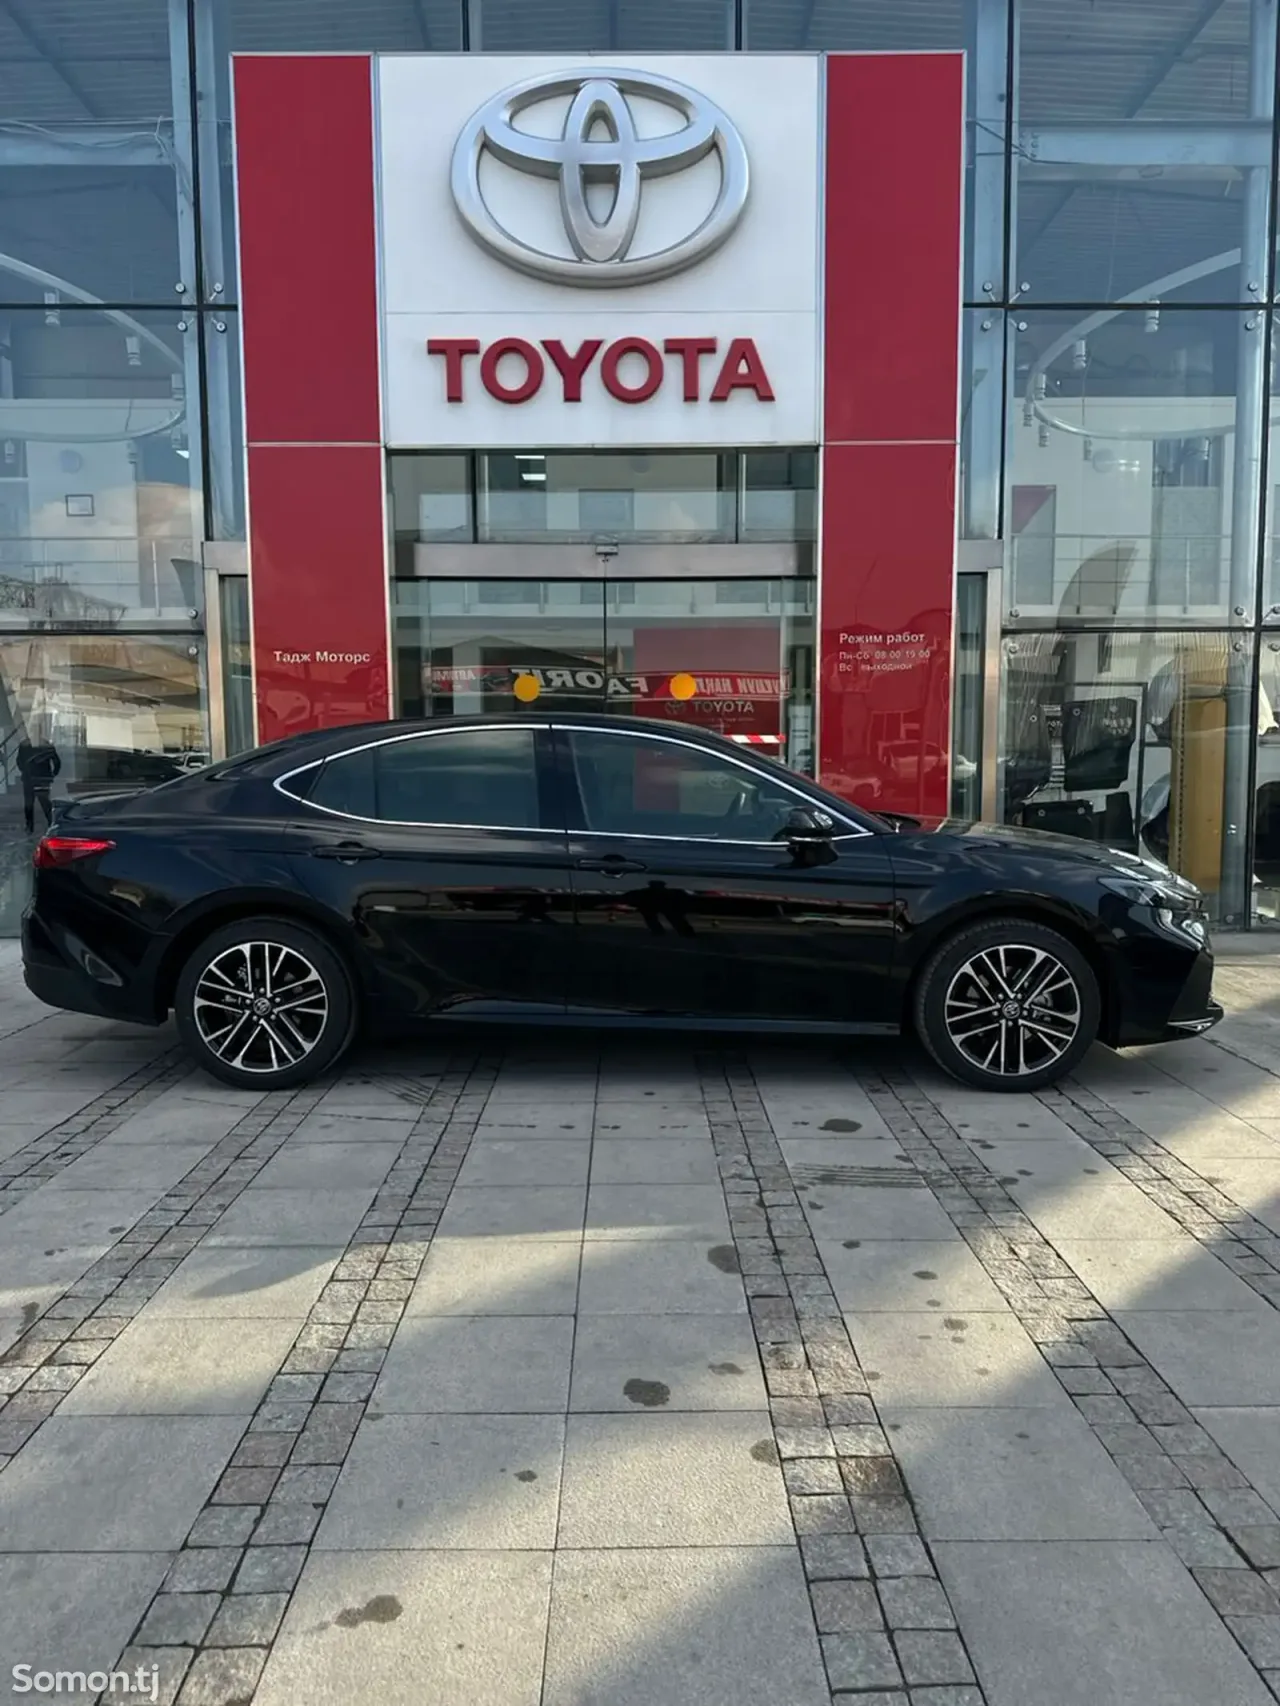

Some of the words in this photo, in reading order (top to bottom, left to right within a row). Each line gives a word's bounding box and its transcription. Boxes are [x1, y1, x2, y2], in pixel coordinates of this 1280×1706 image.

[427, 337, 775, 403] TOYOTA
[839, 632, 883, 644] Режим
[273, 650, 311, 663] Тадж
[315, 650, 371, 665] Моторс
[692, 700, 755, 713] TOYOTA
